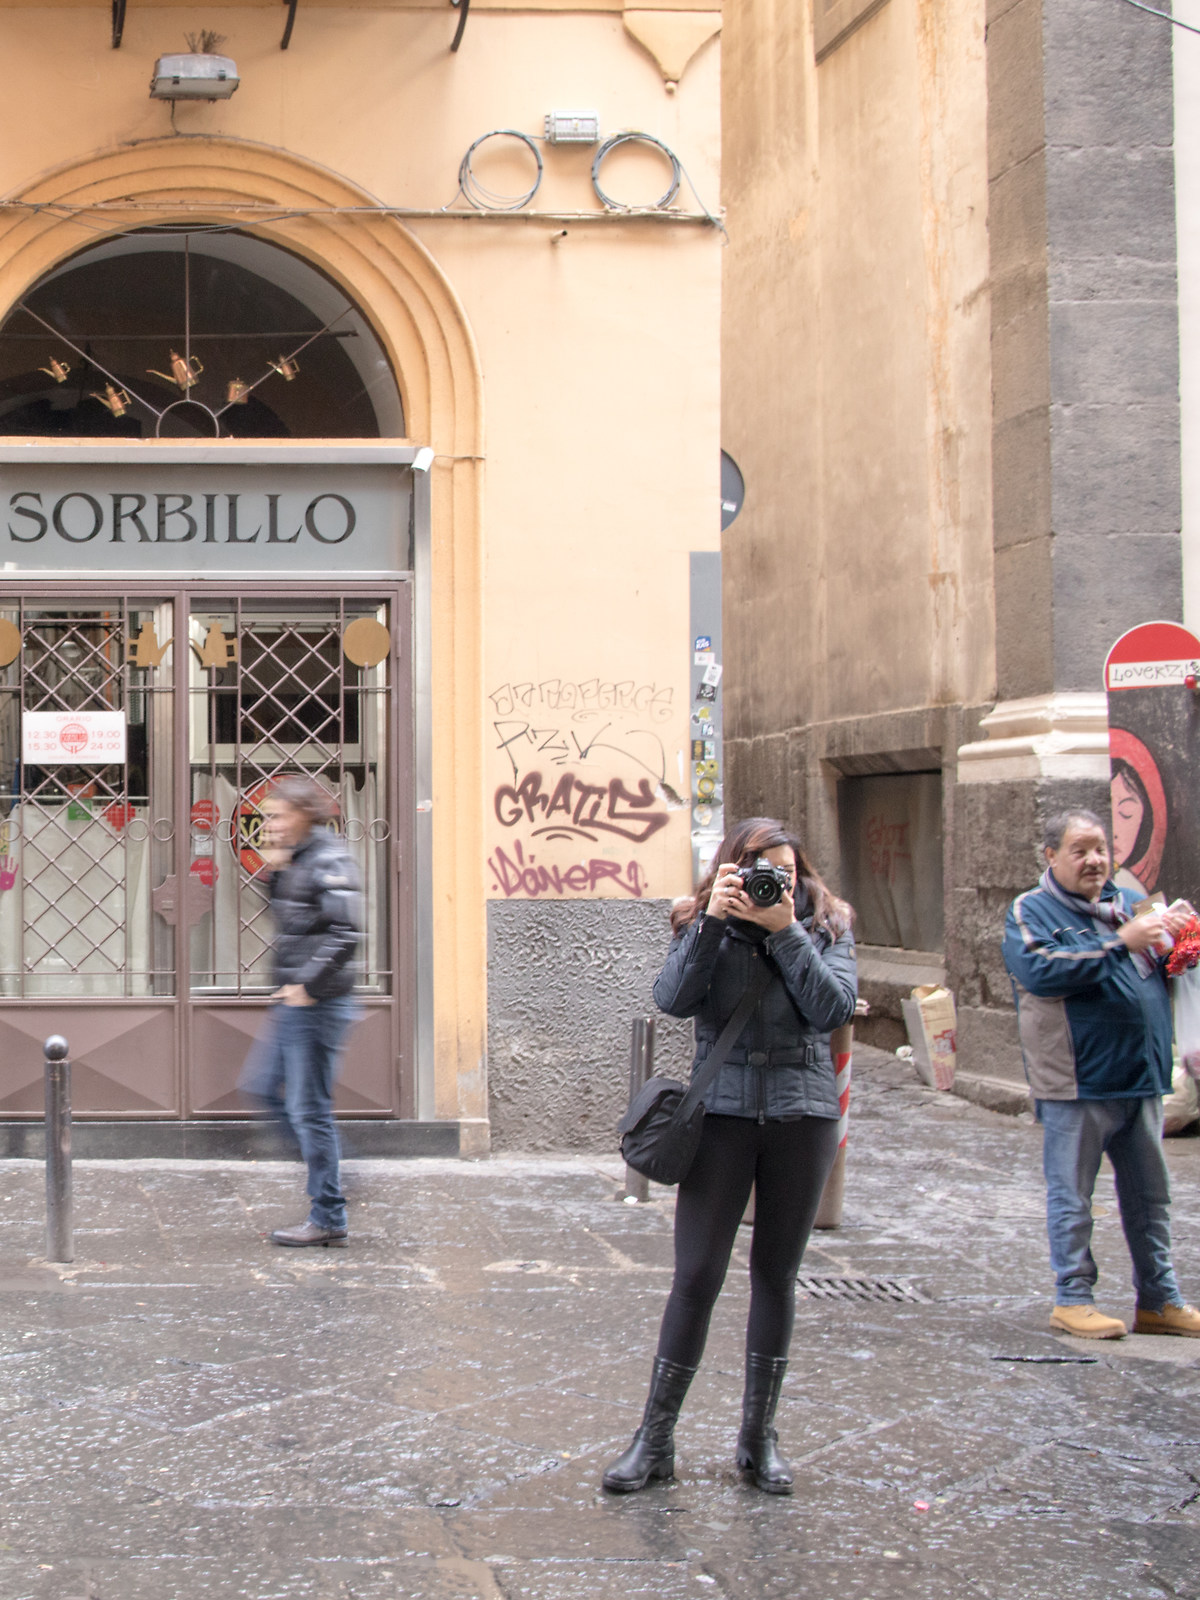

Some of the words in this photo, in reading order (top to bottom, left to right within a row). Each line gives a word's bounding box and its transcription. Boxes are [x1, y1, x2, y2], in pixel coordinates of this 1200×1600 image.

[8, 491, 357, 544] SORBILLO
[27, 730, 57, 739] 12.30
[91, 730, 121, 738] 19.00
[27, 742, 57, 751] 15.30
[90, 742, 121, 750] 24.00
